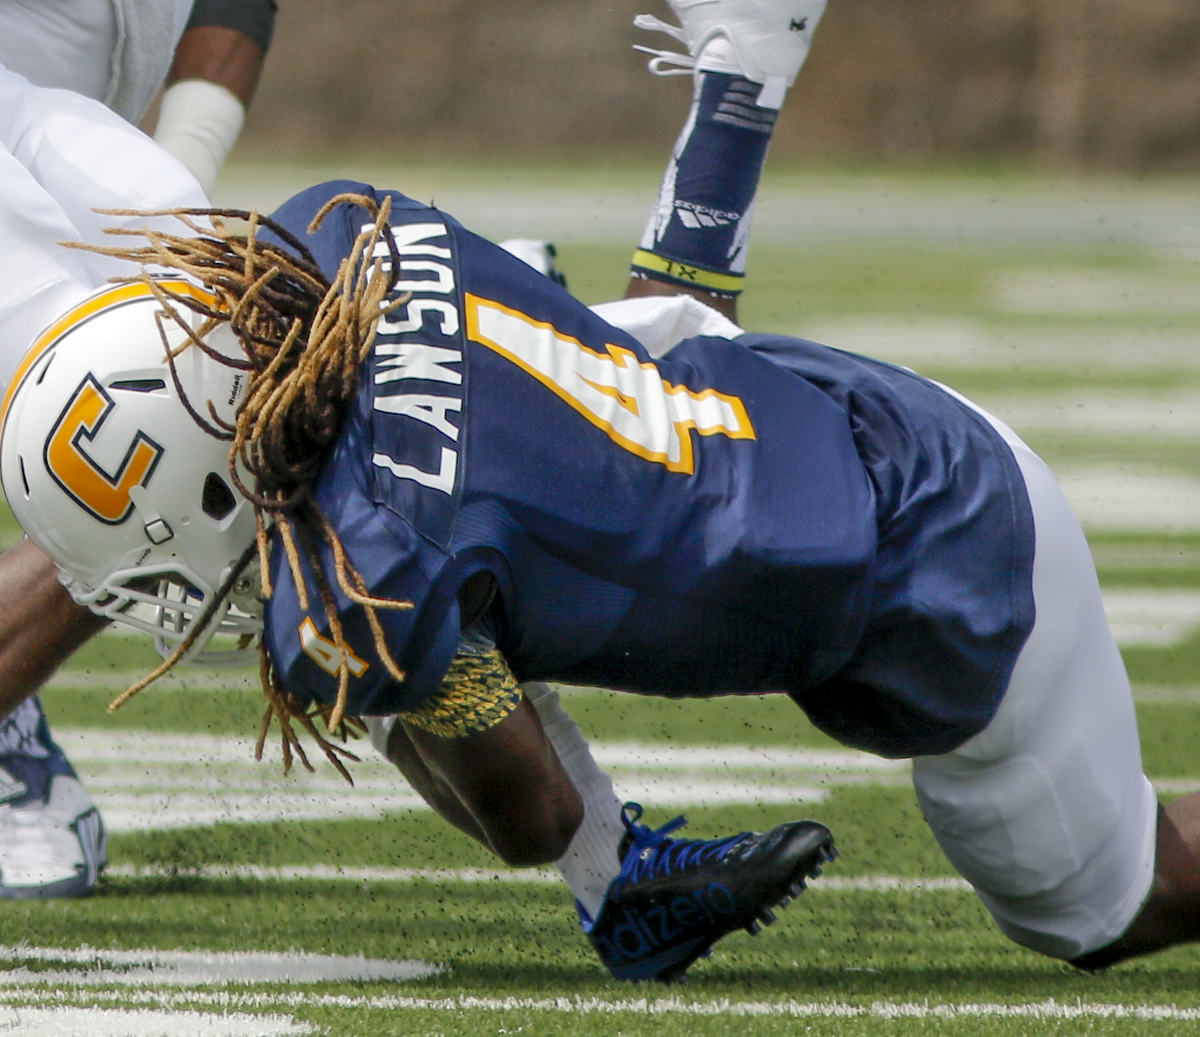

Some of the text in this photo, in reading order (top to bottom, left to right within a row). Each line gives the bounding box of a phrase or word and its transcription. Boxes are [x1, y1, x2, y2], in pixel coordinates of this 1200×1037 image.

[673, 199, 740, 221] adidas
[360, 222, 464, 497] LAWSON
[464, 291, 757, 476] 4
[42, 371, 166, 527] C
[297, 615, 371, 679] 4
